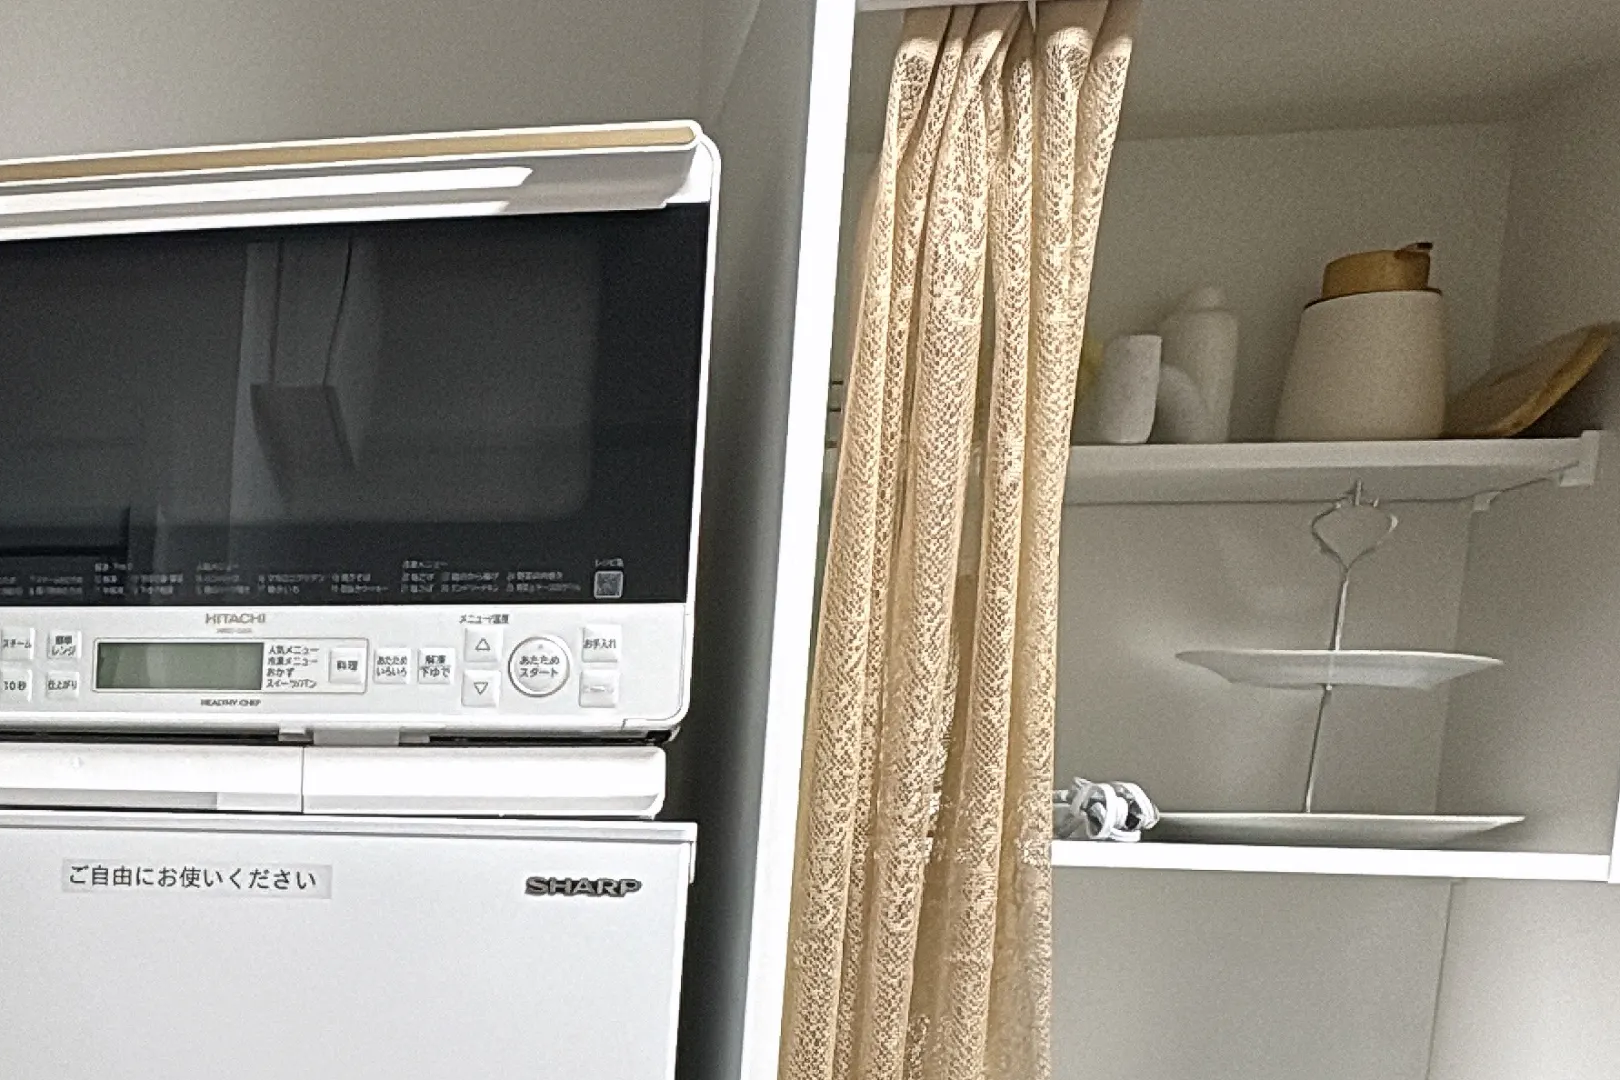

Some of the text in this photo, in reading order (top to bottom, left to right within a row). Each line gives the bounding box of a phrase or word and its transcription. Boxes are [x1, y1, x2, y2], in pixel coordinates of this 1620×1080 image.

[205, 612, 266, 624] HITACHI
[2, 638, 32, 649] スチーム
[583, 638, 617, 649] お手入れ
[51, 645, 77, 656] レンジ
[520, 655, 560, 666] あたため
[266, 667, 295, 678] おかず
[520, 667, 559, 678] スタート
[68, 864, 318, 891] ご自由にお使いください
[524, 876, 643, 897] SHARP
